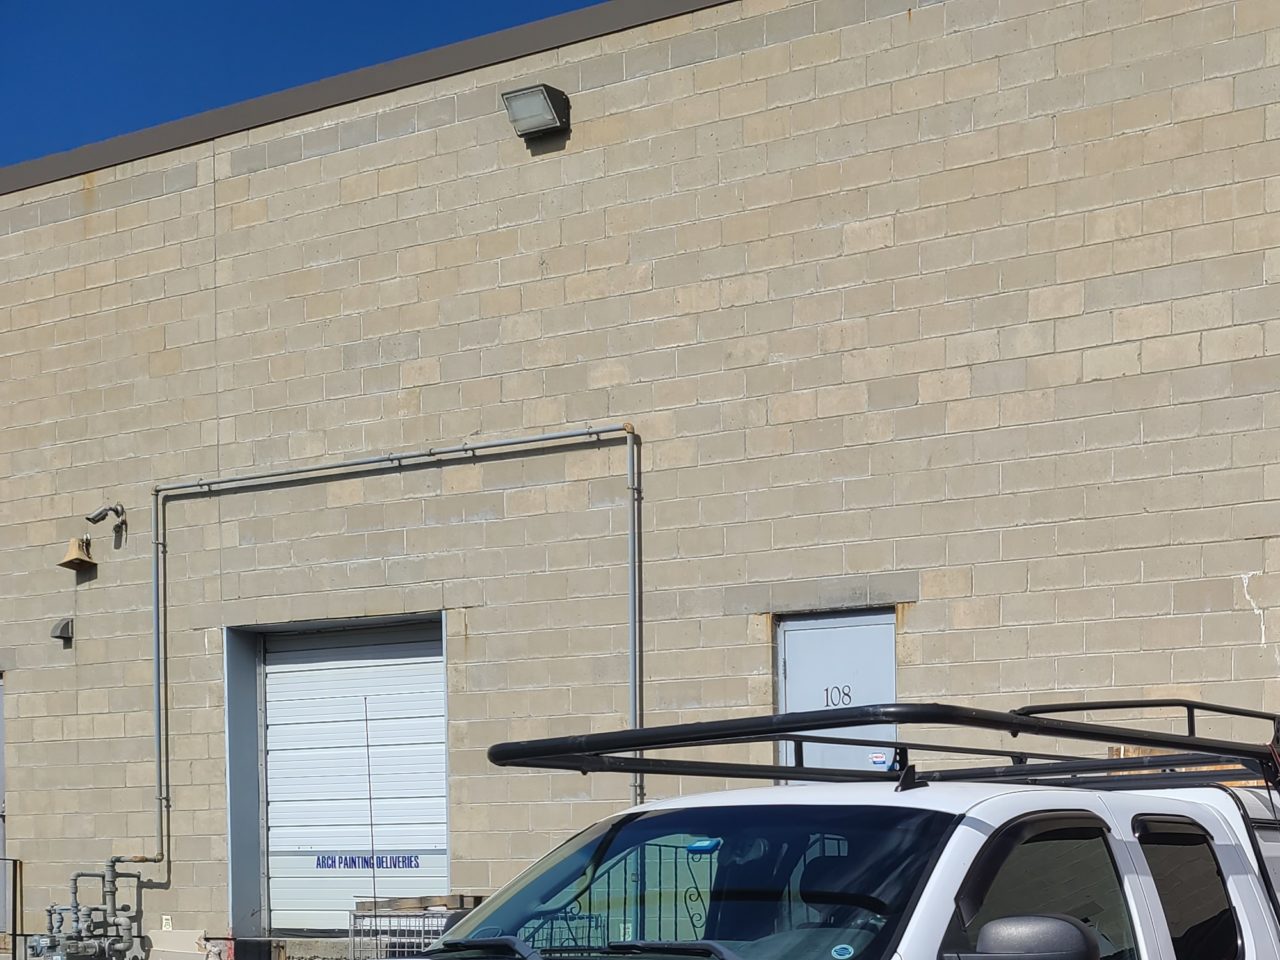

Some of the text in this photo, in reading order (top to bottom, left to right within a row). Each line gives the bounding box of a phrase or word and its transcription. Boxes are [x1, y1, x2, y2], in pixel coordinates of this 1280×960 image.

[823, 685, 852, 708] 108
[316, 855, 420, 869] ARCH PAINTING DELIVERIES
